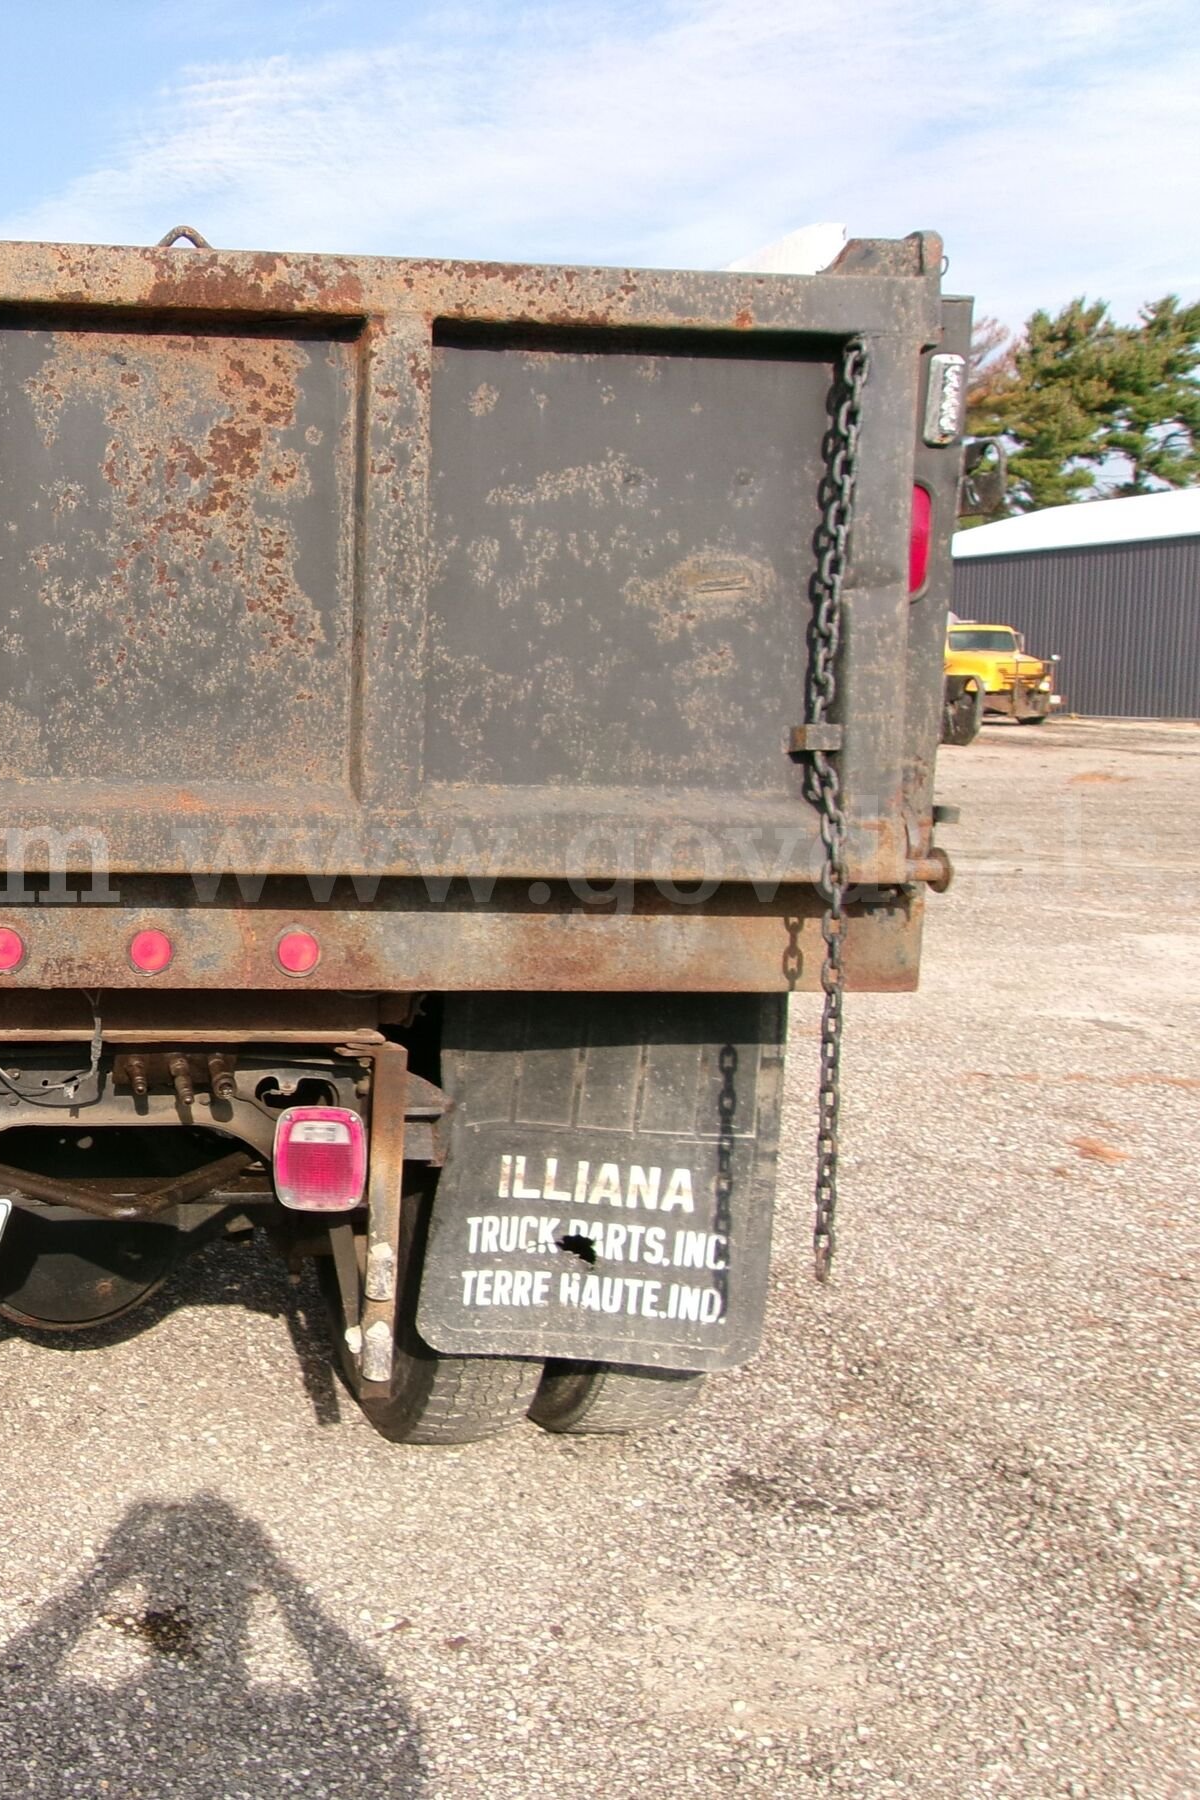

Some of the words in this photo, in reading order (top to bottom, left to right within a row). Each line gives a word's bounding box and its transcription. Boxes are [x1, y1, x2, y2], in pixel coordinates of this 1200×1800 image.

[498, 1155, 695, 1213] ILLIANA
[466, 1216, 561, 1254] TRUCK
[461, 1269, 552, 1307] TERRE
